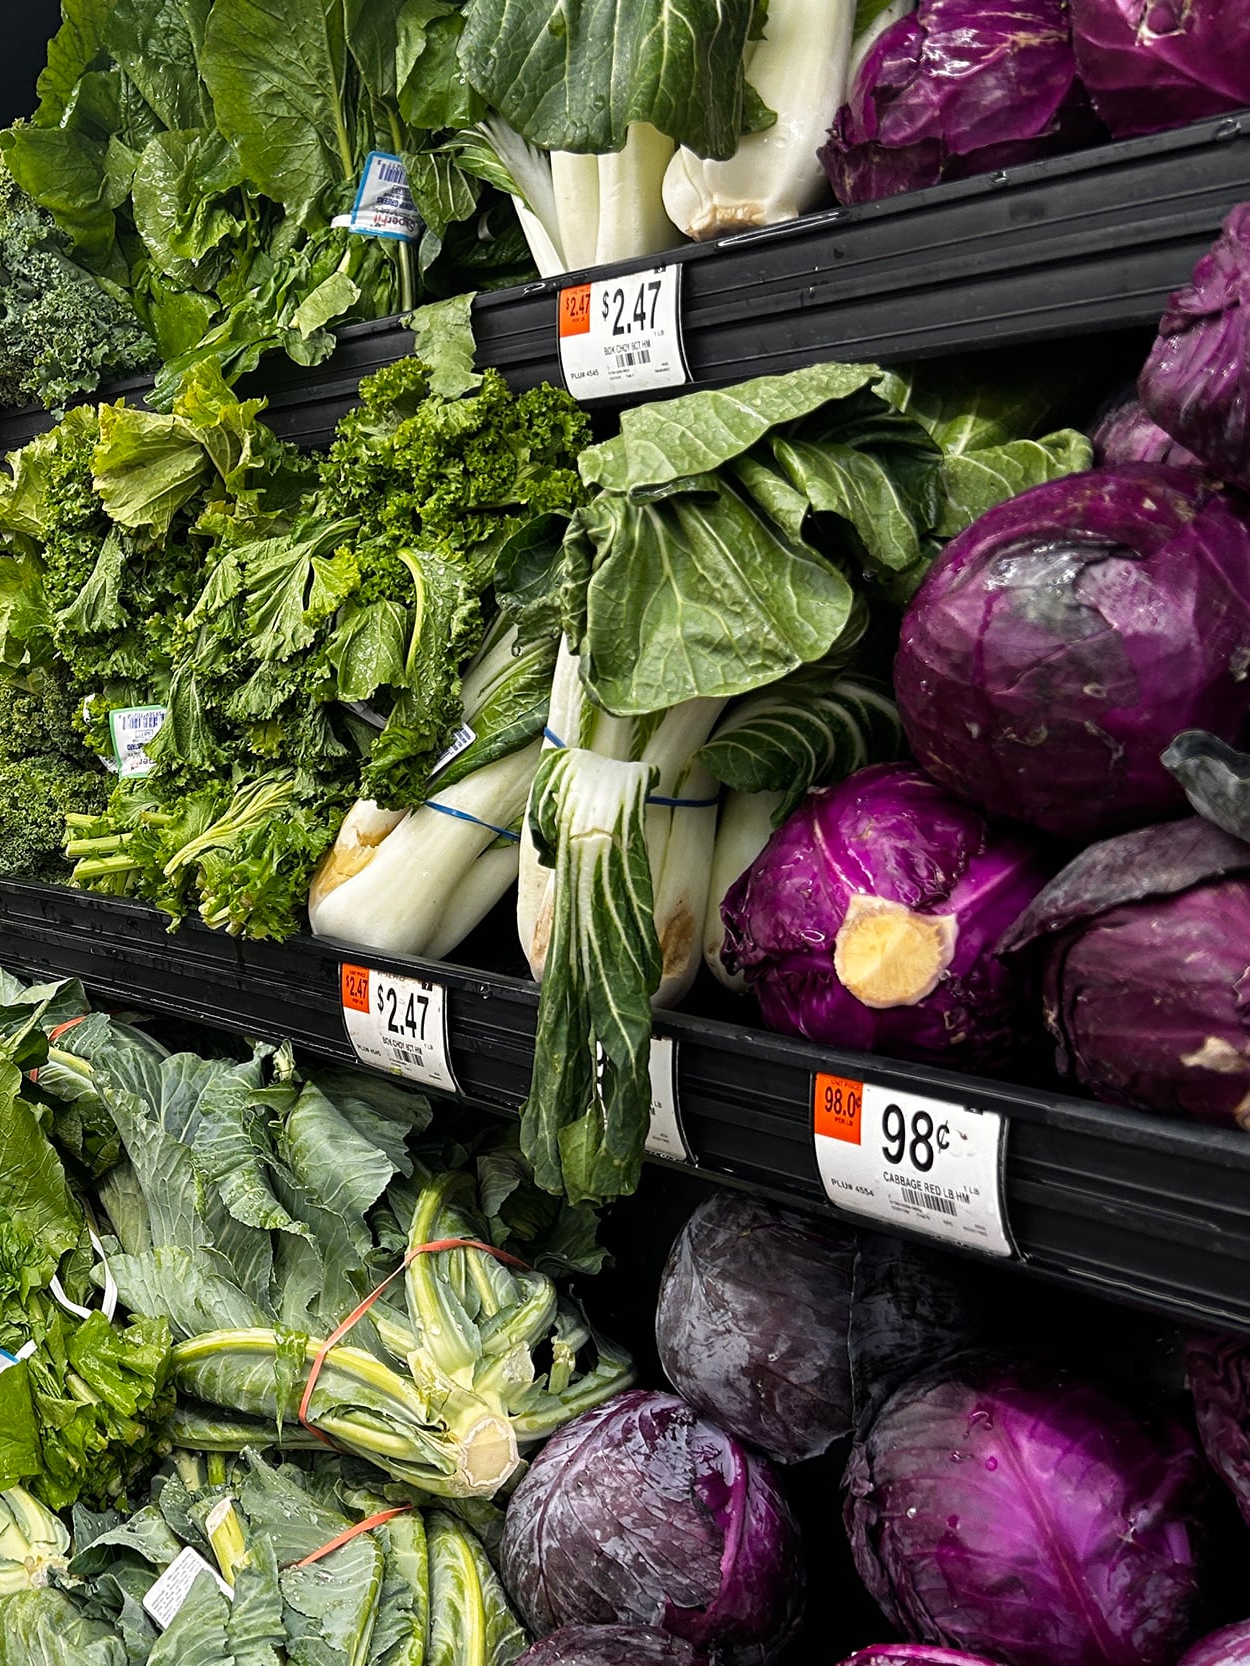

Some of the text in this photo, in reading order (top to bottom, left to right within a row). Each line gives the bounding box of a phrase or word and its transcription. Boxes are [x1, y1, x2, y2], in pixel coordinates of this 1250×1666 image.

[566, 293, 591, 318] $2.47
[602, 280, 662, 336] $2.47
[346, 974, 368, 999] $2.47
[377, 984, 429, 1041] $2.47
[881, 1103, 951, 1172] 98¢
[830, 1178, 853, 1191] PLU#
[882, 1171, 970, 1204] CABBAGE RED LB HM
